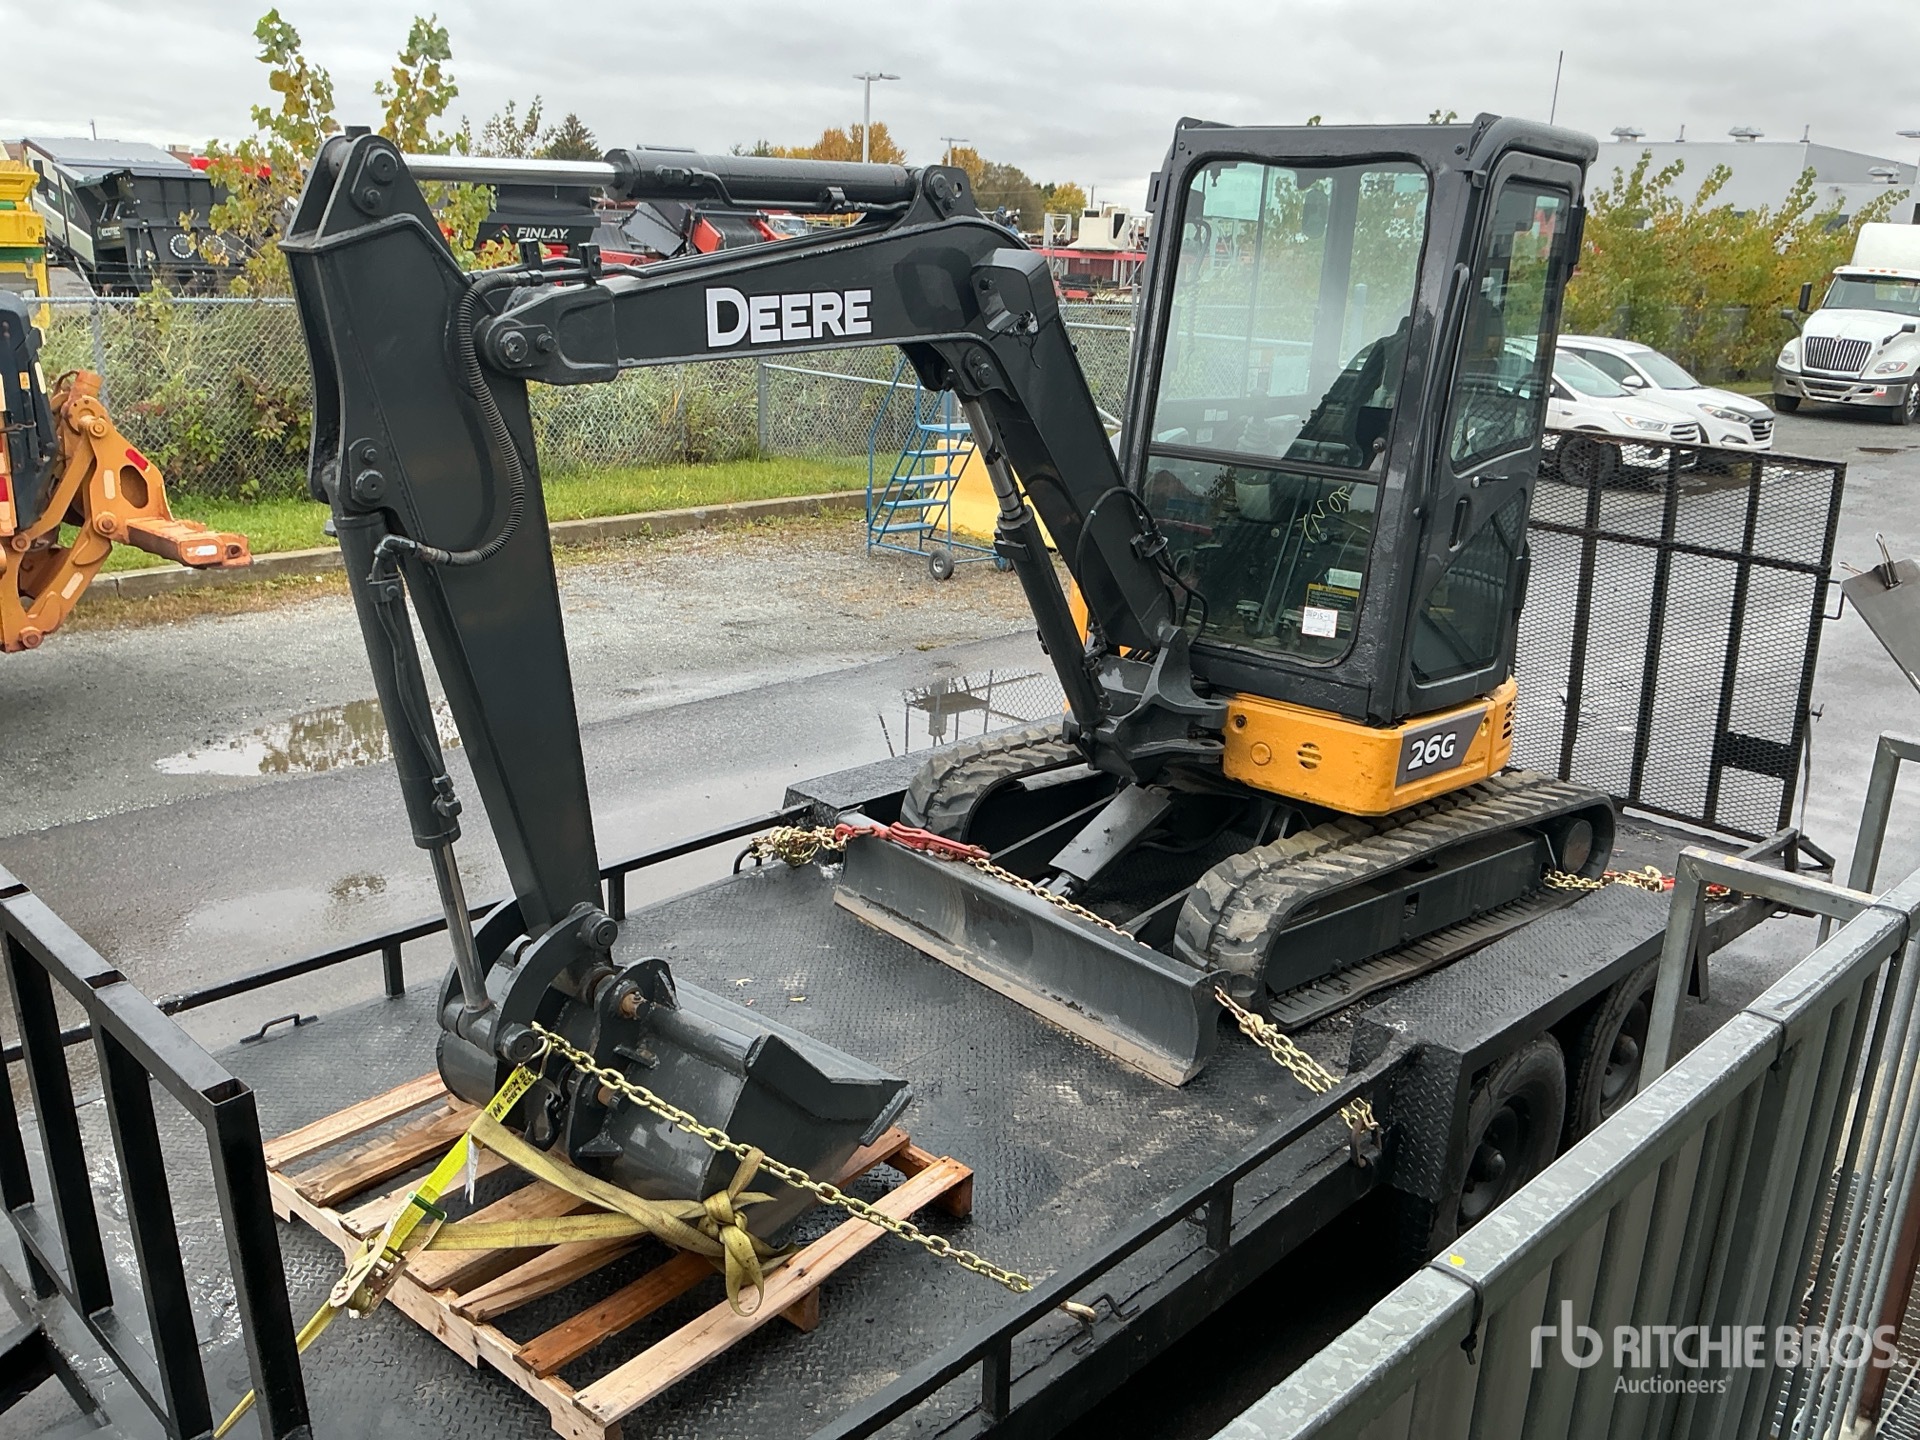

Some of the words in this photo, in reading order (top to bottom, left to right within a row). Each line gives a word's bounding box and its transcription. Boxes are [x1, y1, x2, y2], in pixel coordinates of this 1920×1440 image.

[516, 227, 569, 239] FINLAY
[706, 287, 872, 348] DEERE
[1407, 732, 1456, 771] 26G
